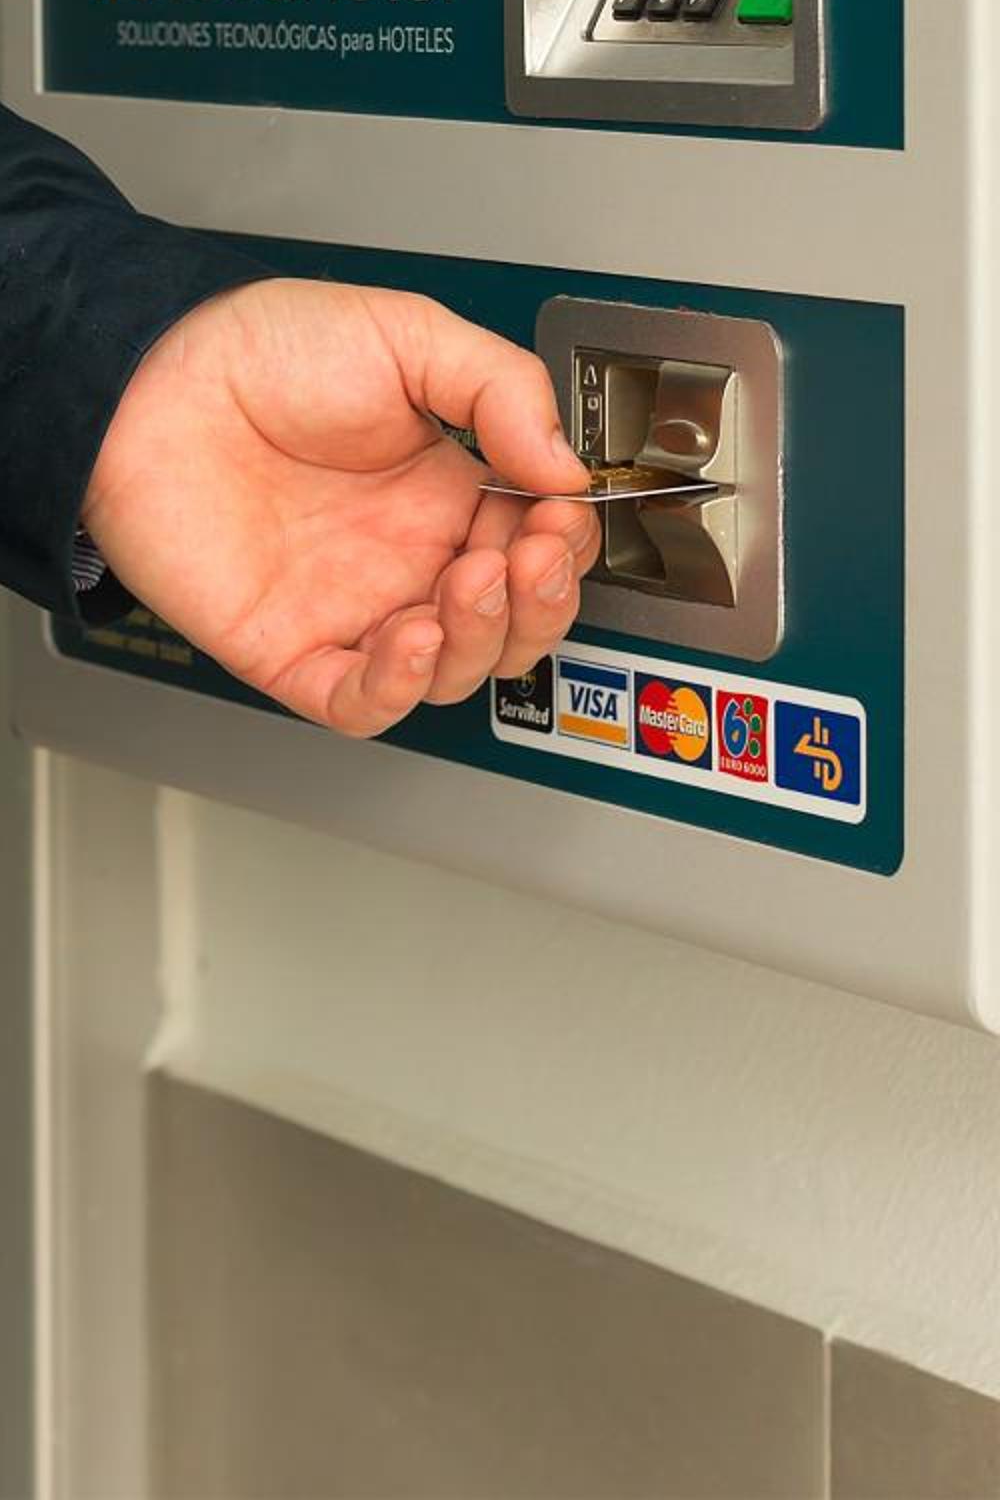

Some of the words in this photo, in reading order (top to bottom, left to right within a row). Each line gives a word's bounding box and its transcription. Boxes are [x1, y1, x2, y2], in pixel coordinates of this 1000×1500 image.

[116, 20, 212, 48] SOLUCIONES
[215, 19, 337, 51] TECNOLÓGICAS
[340, 29, 375, 58] para
[379, 26, 454, 54] HOTELES
[500, 697, 550, 725] ServiRed
[568, 683, 619, 722] VISA
[639, 704, 708, 738] MasterCard
